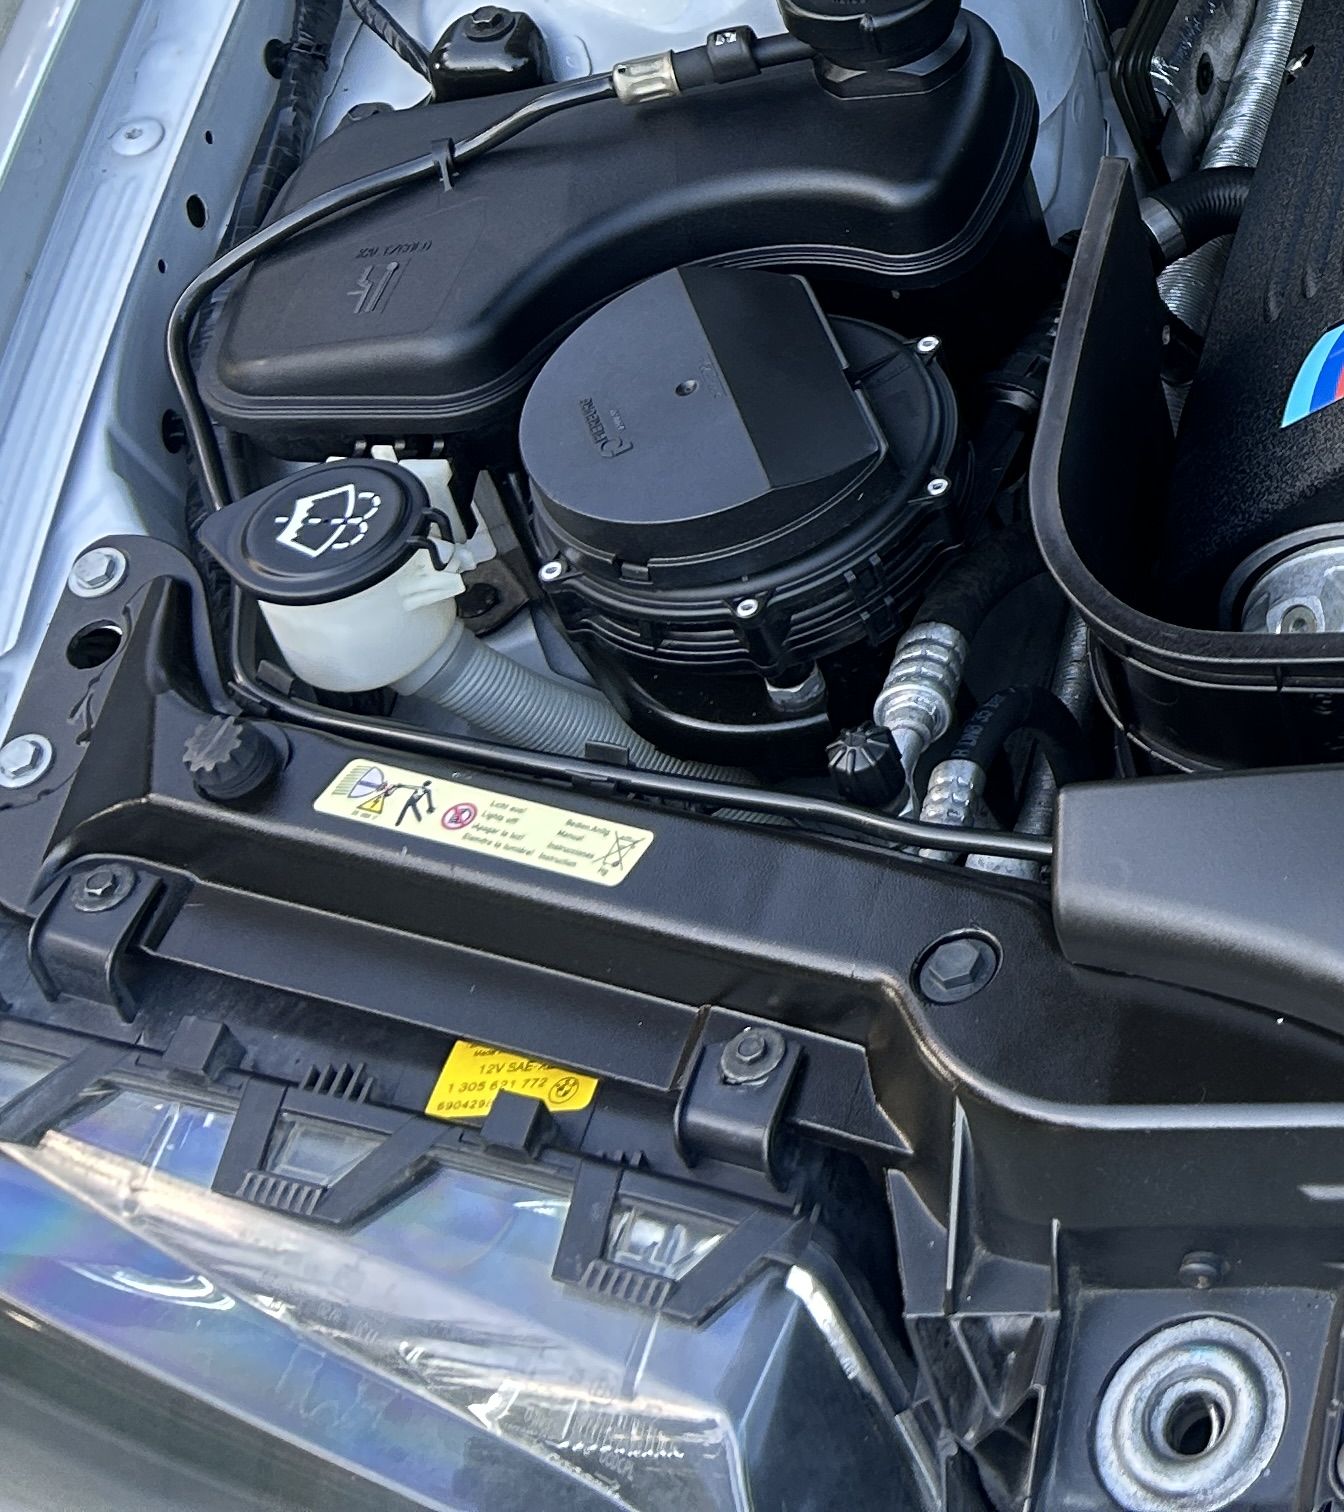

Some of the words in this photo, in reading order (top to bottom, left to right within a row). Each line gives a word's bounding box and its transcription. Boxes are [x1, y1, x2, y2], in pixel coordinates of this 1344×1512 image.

[479, 1063, 505, 1074] 12V
[459, 1080, 485, 1093] 305
[521, 1077, 549, 1089] 772
